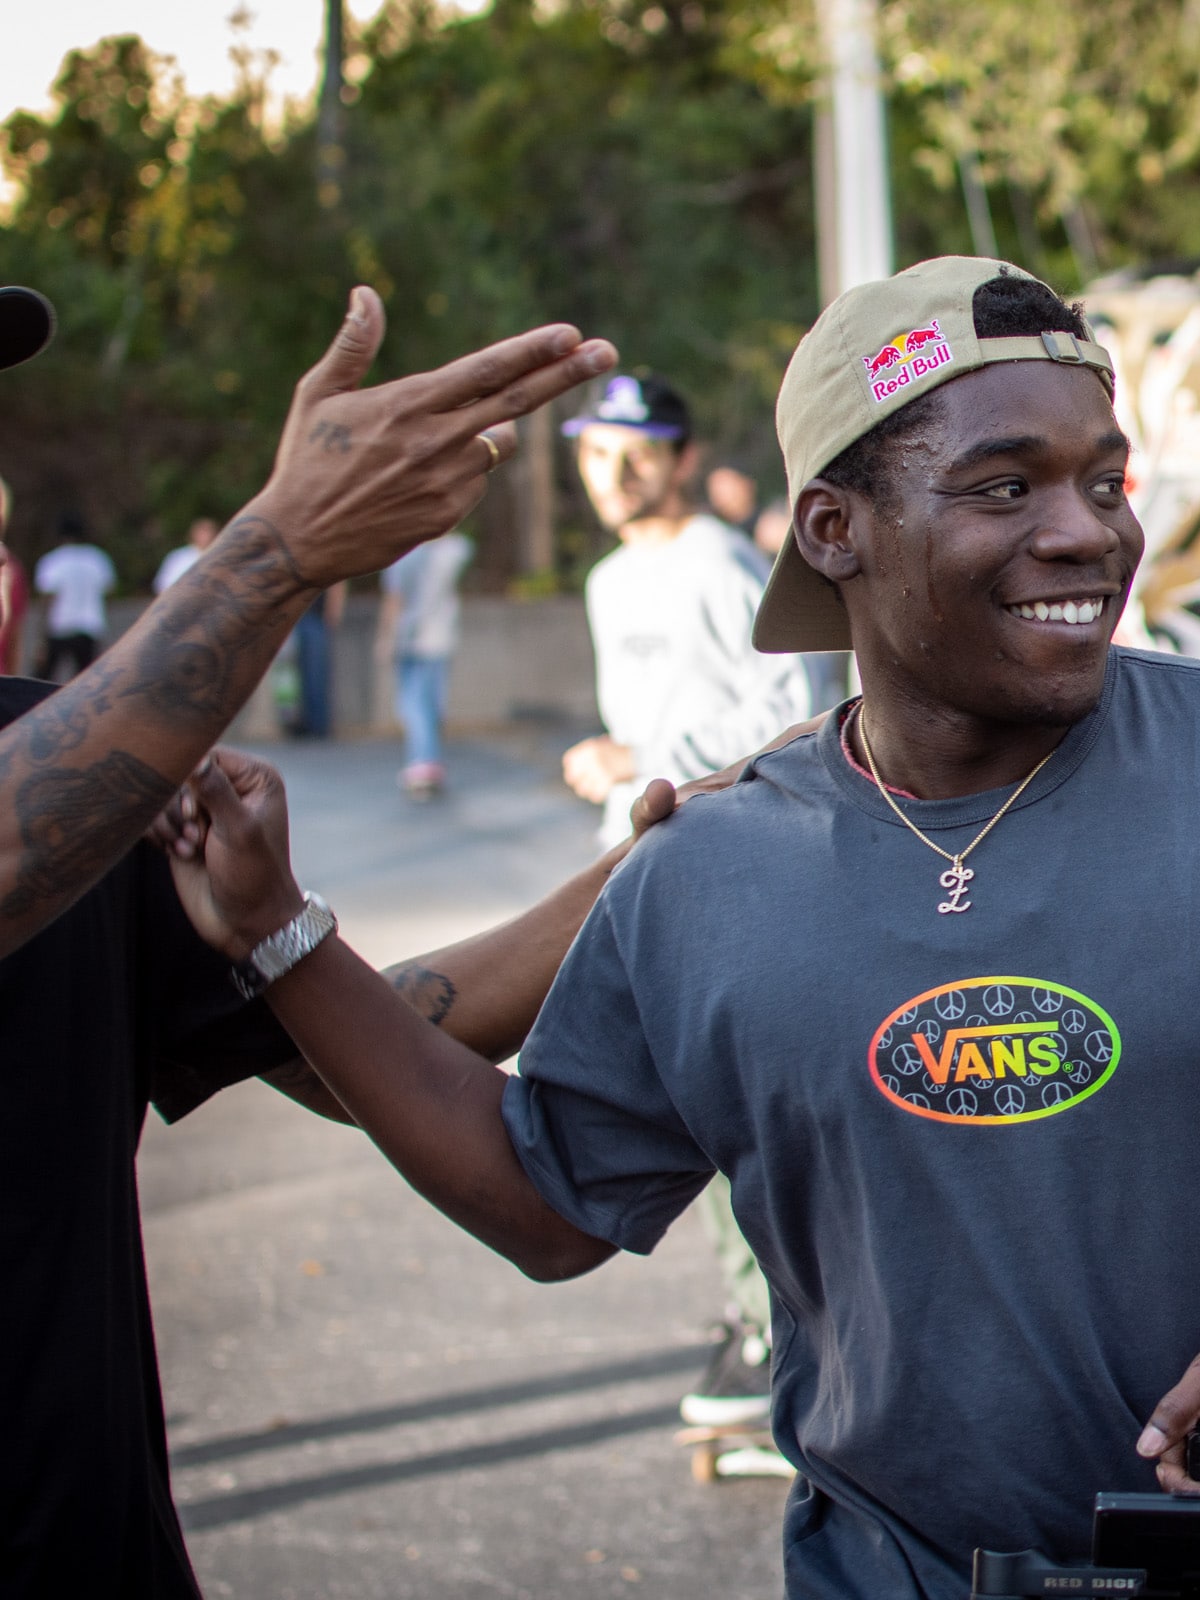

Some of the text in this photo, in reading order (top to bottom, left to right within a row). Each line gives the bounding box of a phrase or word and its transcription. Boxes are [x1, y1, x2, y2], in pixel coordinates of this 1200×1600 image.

[872, 343, 951, 401] Red Bull
[911, 1020, 1061, 1085] VANS
[1043, 1577, 1083, 1589] RED
